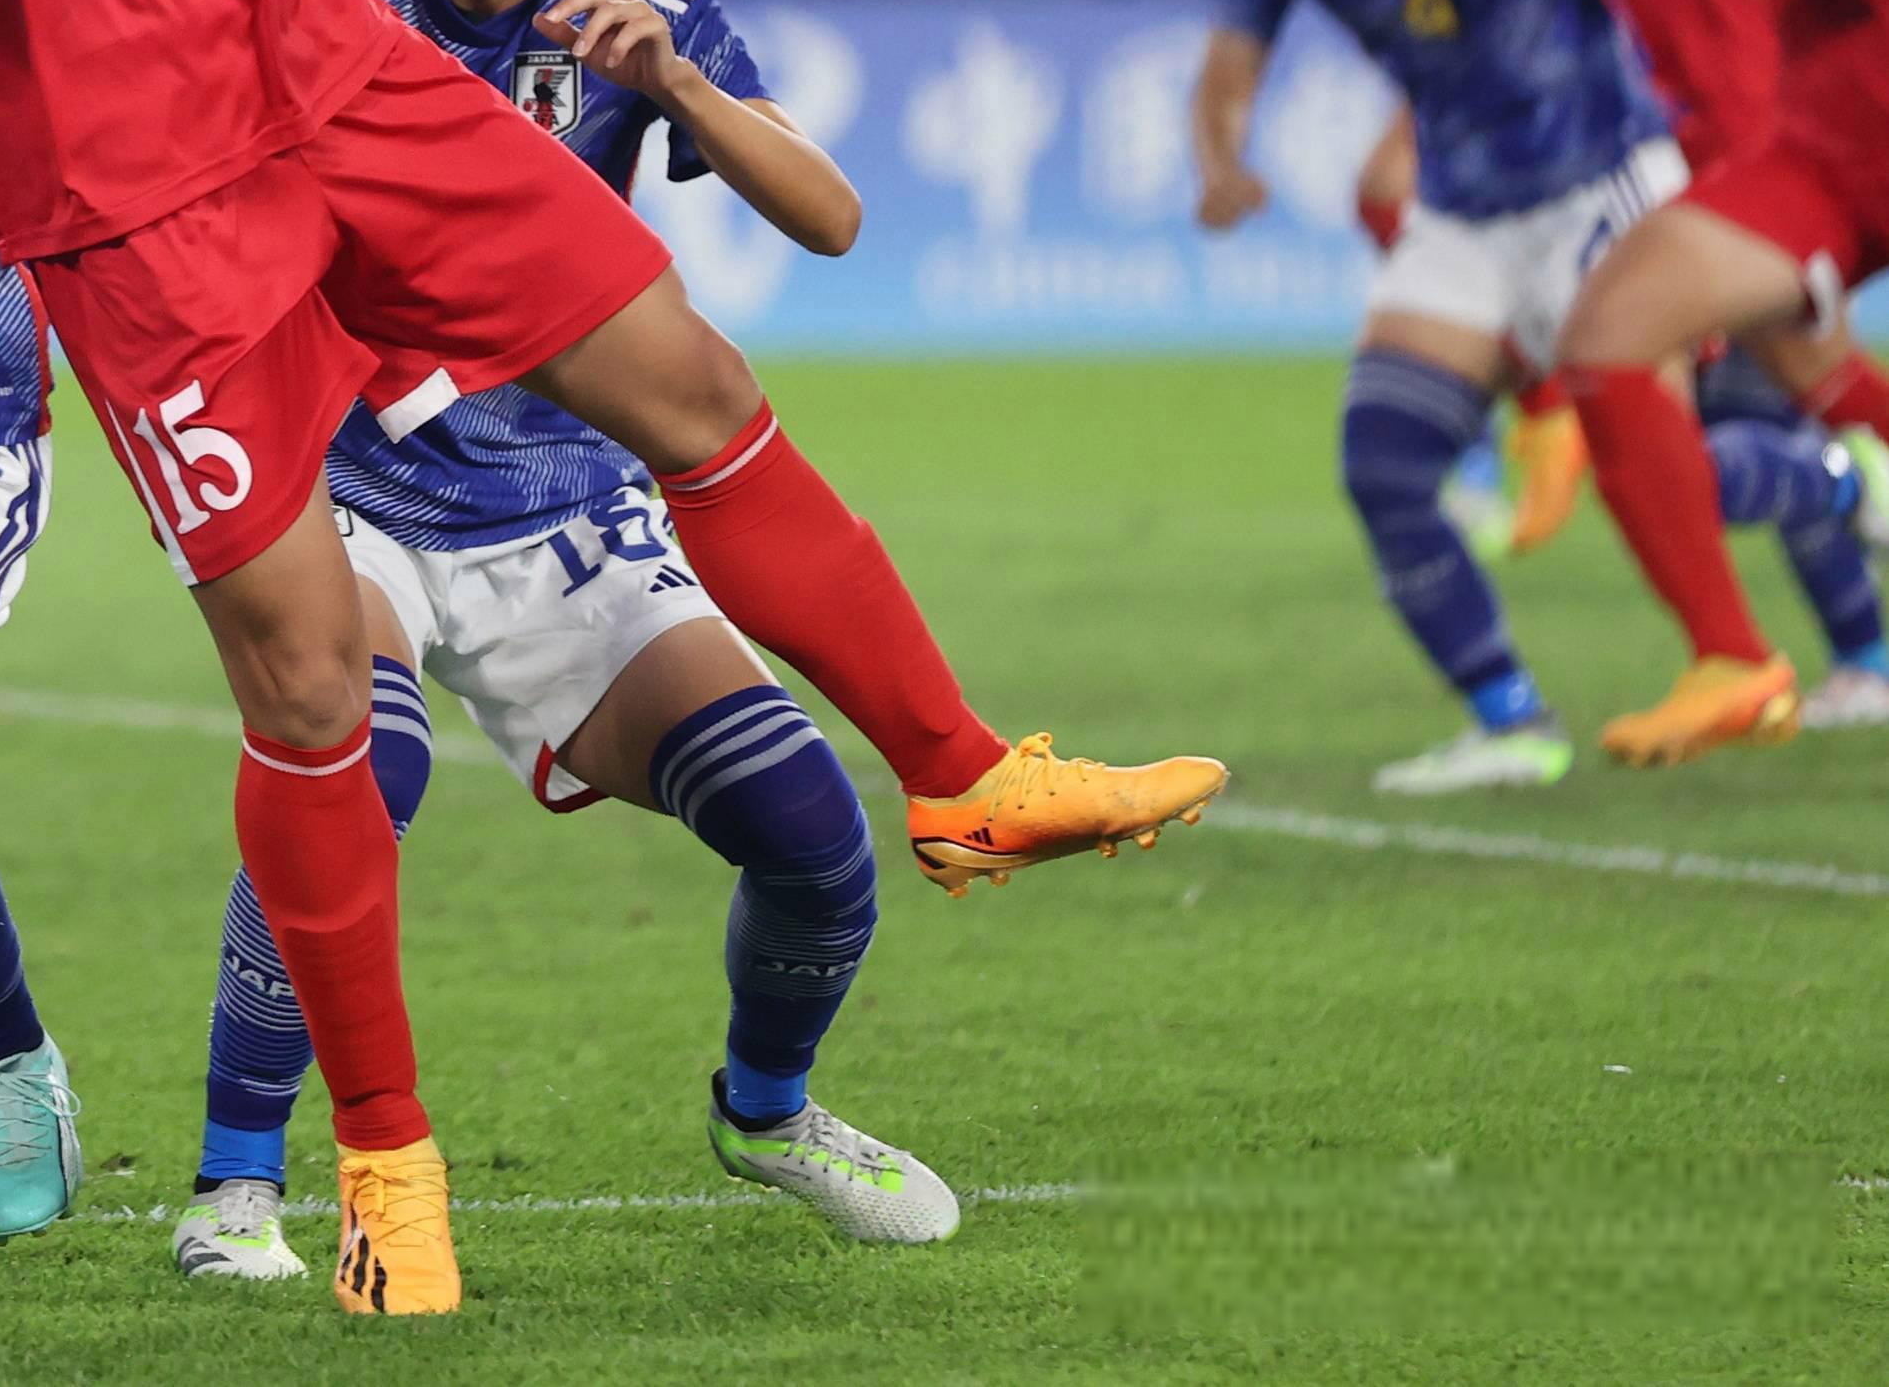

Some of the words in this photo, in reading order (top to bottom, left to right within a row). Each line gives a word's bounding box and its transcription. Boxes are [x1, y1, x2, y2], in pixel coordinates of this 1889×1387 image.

[526, 55, 564, 64] JAPAN
[132, 379, 254, 535] 15
[223, 955, 297, 999] JAP
[755, 960, 856, 977] JAP
